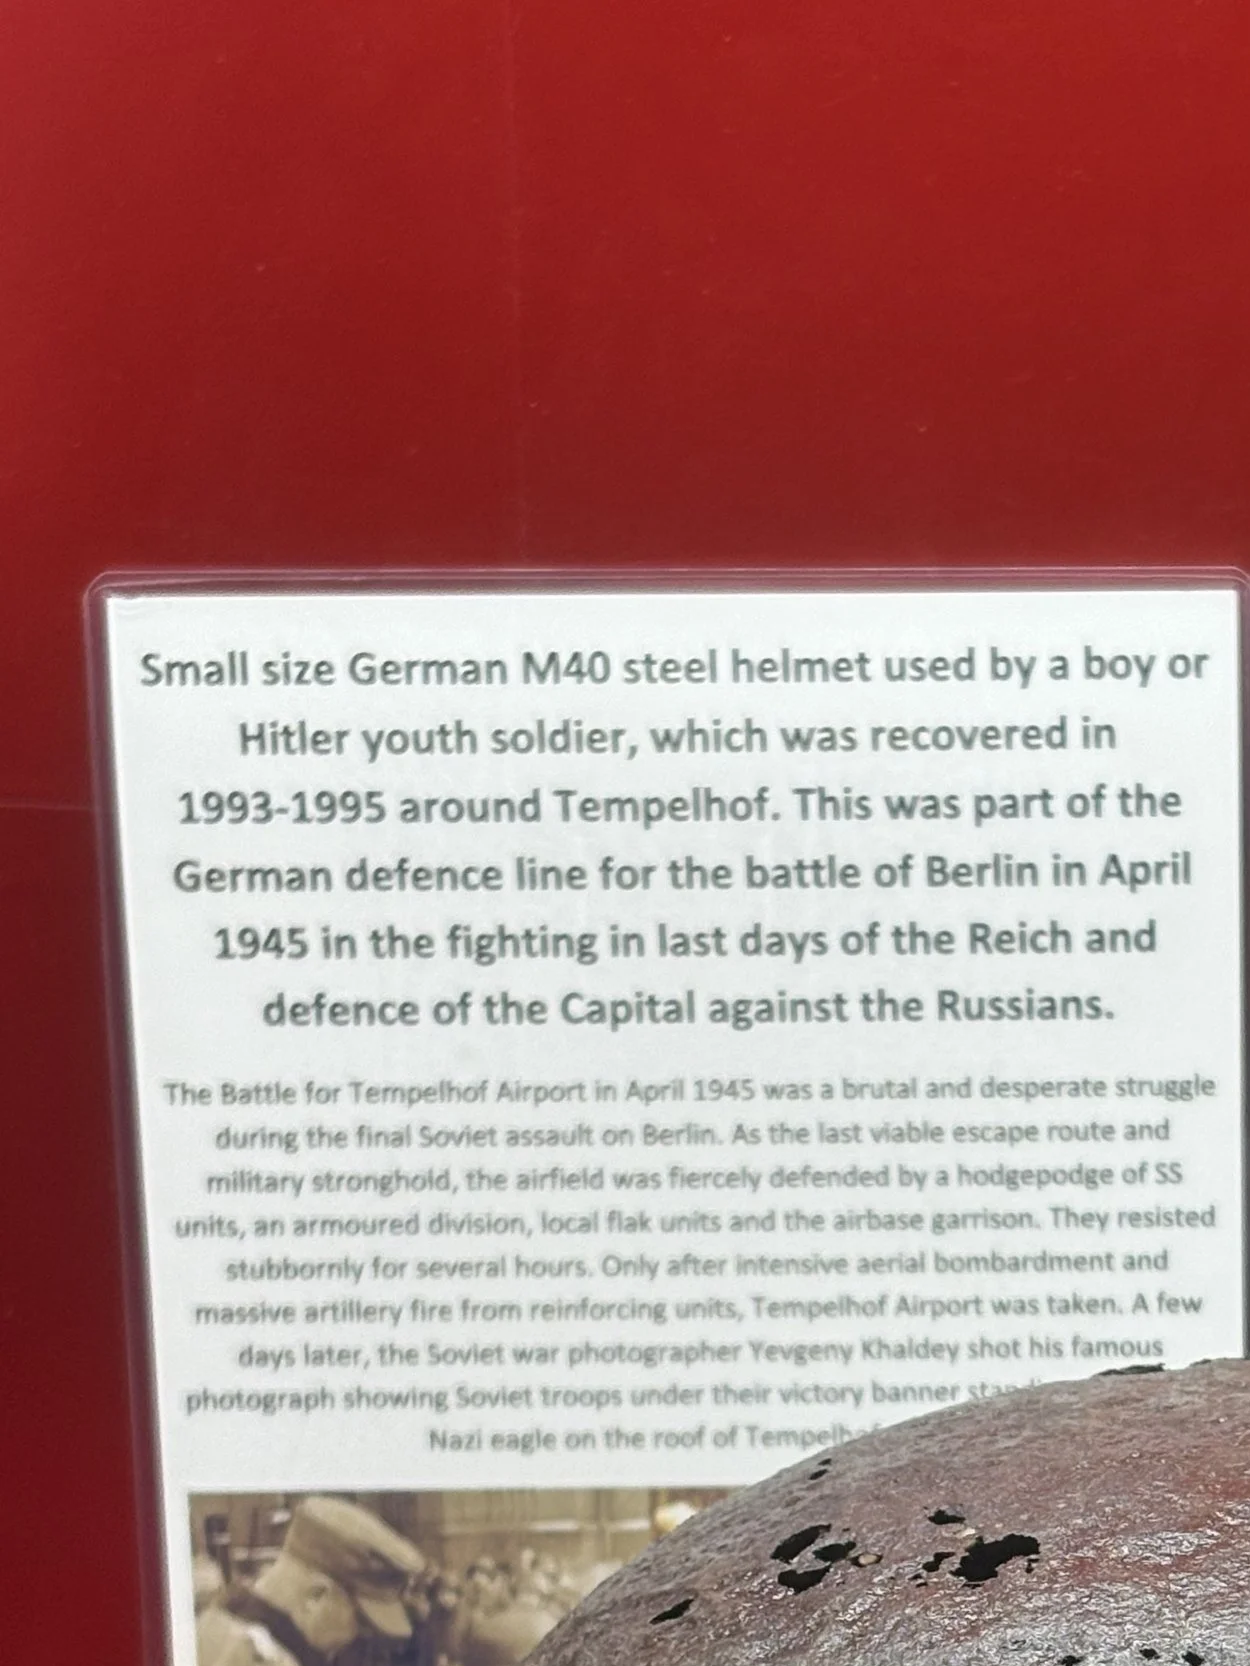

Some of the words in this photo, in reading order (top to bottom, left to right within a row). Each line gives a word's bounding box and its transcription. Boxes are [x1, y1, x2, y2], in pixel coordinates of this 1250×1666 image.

[140, 651, 249, 687] Small
[262, 651, 336, 686] size
[348, 651, 508, 685] German
[522, 651, 611, 685] M40
[623, 648, 717, 684] steel
[731, 647, 872, 683] helmet
[884, 648, 975, 682] used
[990, 646, 1037, 689] by
[1048, 655, 1069, 680] a
[1084, 645, 1156, 689] boy
[1167, 654, 1210, 679] or
[239, 720, 350, 756] Hitler
[360, 720, 478, 764] youth
[490, 718, 638, 760] soldier,
[649, 718, 767, 753] which
[780, 727, 858, 752] was
[871, 716, 1068, 751] recovered
[1082, 716, 1116, 749] in
[179, 789, 386, 824] 1993-1995
[399, 788, 541, 823] around
[552, 786, 781, 830] Tempelhof.
[792, 786, 873, 821] This
[883, 795, 961, 821] was
[974, 788, 1055, 828] part
[1066, 783, 1107, 818] of
[1117, 783, 1182, 818] the
[172, 858, 333, 893] German
[345, 856, 503, 892] defence
[516, 855, 587, 890] line
[598, 856, 657, 890] for
[666, 855, 733, 890] the
[745, 854, 861, 889] battle
[873, 853, 914, 888] of
[926, 853, 1039, 887] Berlin
[1052, 853, 1087, 886] in
[1098, 851, 1191, 894] April
[214, 926, 309, 961] 1945
[320, 925, 357, 959] in
[368, 924, 435, 959] the
[446, 924, 599, 967] fighting
[609, 924, 645, 957] in
[658, 923, 728, 957] last
[739, 921, 829, 964] days
[840, 921, 880, 956] of
[890, 921, 955, 956] the
[969, 920, 1072, 955] Reich
[1085, 918, 1157, 953] and
[263, 991, 419, 1027] defence
[432, 991, 473, 1026] of
[482, 991, 548, 1026] the
[560, 990, 695, 1032] Capital
[708, 990, 849, 1031] against
[859, 988, 924, 1022] the
[937, 988, 1114, 1021] Russians.
[163, 1079, 213, 1106] The
[219, 1080, 297, 1106] Battle
[303, 1080, 342, 1105] for
[347, 1076, 489, 1110] Tempelhof
[495, 1080, 588, 1108] Airport
[594, 1079, 617, 1102] in
[625, 1078, 685, 1107] April
[694, 1078, 756, 1101] 1945
[762, 1083, 814, 1101] was
[820, 1082, 834, 1101] a
[841, 1077, 918, 1101] brutal
[925, 1076, 973, 1099] and
[980, 1074, 1108, 1103] desperate
[1115, 1073, 1216, 1102] struggle
[430, 1428, 483, 1452] Nazi
[490, 1428, 557, 1456] eagle
[563, 1429, 596, 1451] on
[602, 1426, 646, 1450] the
[651, 1425, 706, 1449] roof
[712, 1424, 738, 1448] of
[746, 1423, 881, 1450] Tempelh
